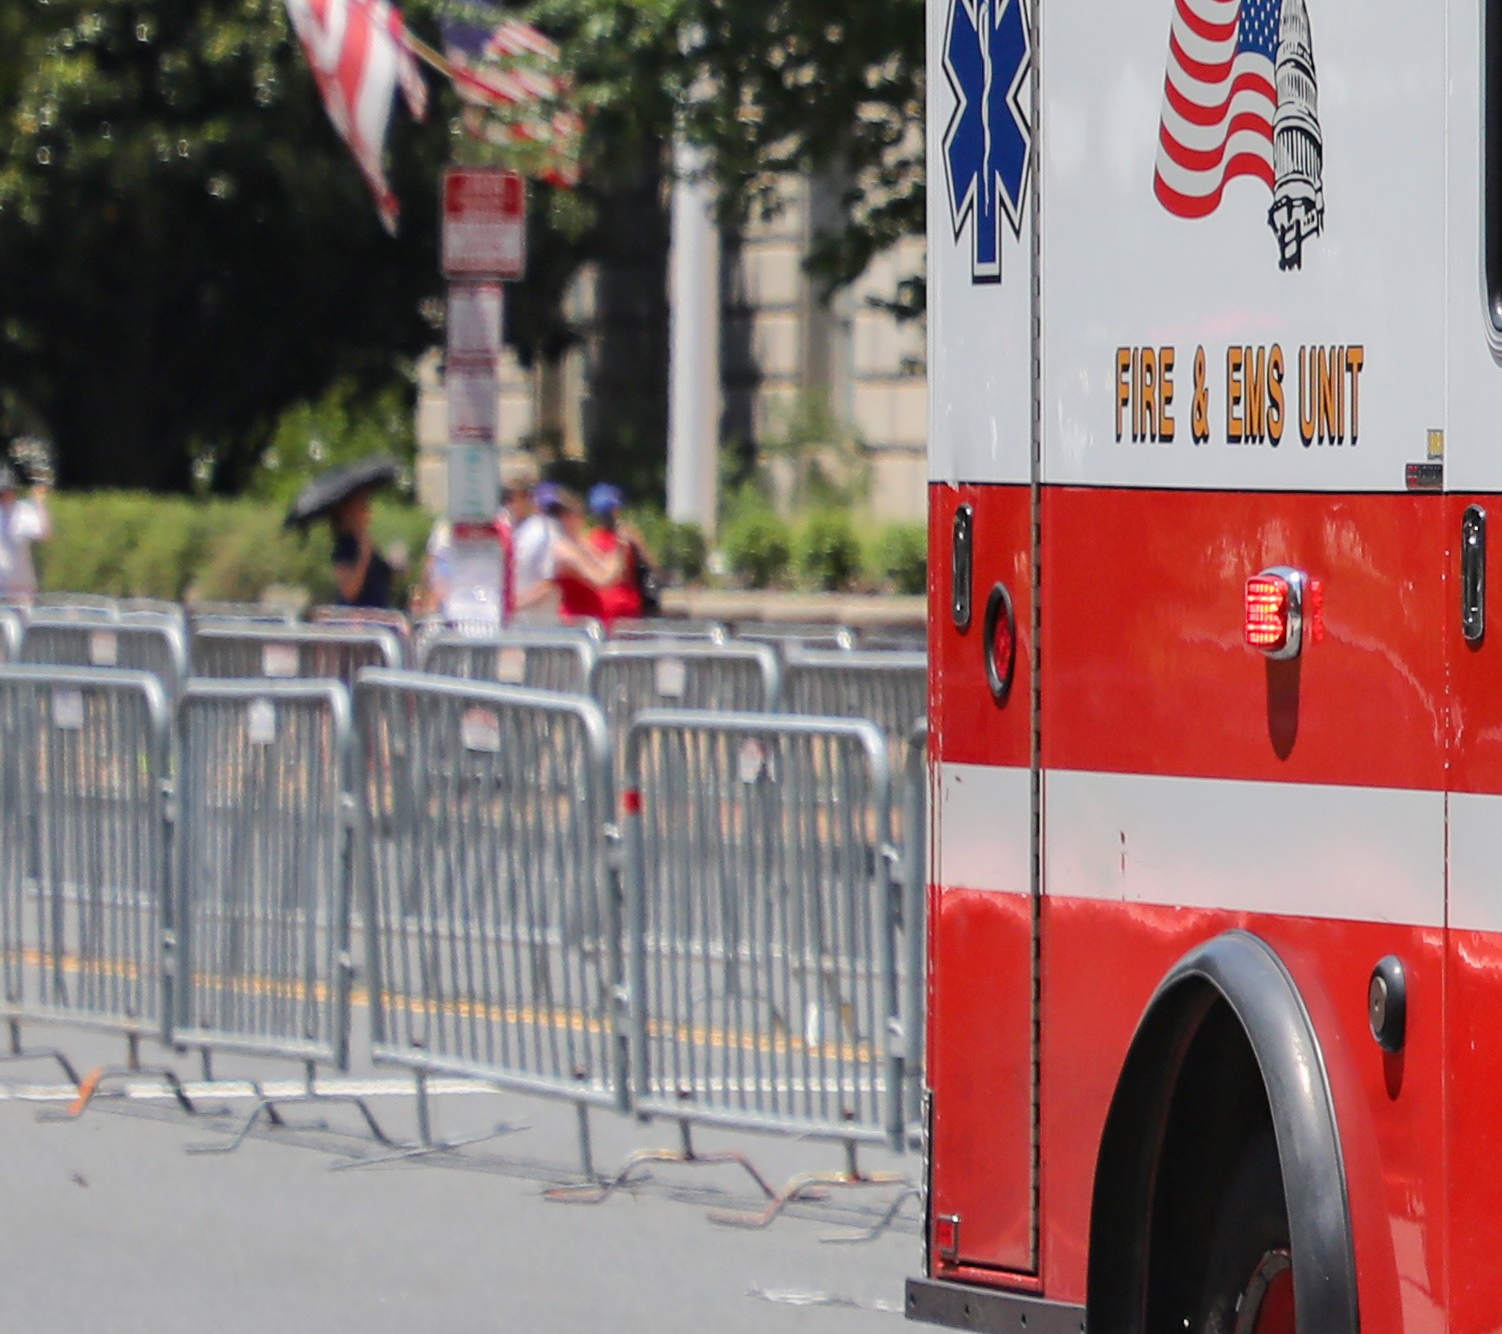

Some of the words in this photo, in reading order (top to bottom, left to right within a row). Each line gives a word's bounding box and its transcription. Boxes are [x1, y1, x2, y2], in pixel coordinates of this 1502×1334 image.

[1115, 346, 1175, 445] FIRE
[1191, 346, 1211, 442] &
[1226, 343, 1285, 447] EMS
[1299, 344, 1364, 448] UNIT
